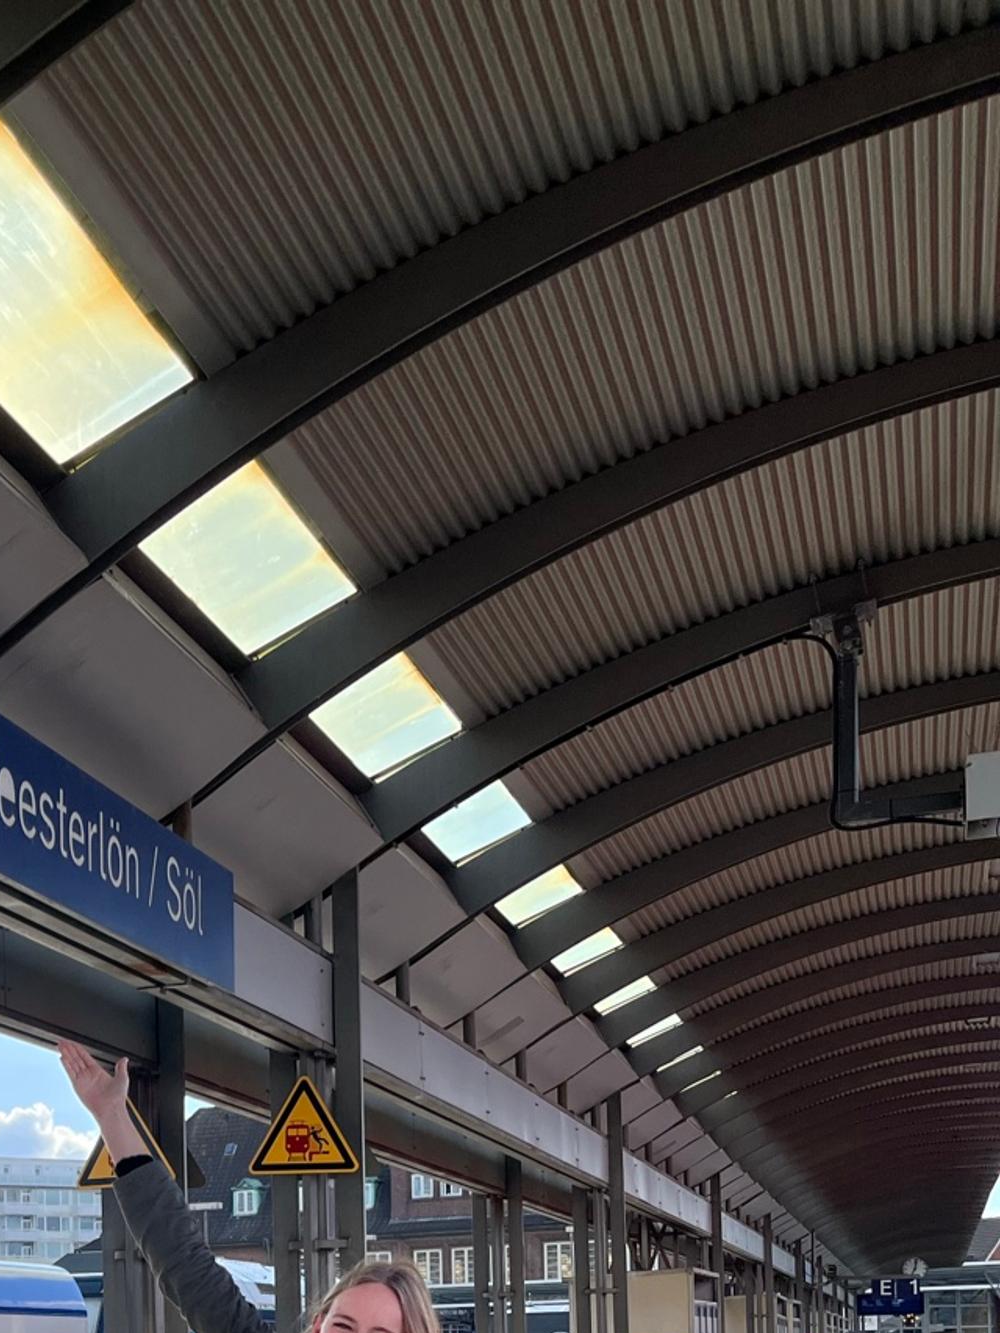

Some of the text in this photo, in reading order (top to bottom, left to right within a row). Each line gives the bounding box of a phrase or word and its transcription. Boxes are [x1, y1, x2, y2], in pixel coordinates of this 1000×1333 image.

[149, 846, 158, 908] /
[167, 855, 203, 936] Söl
[880, 1279, 918, 1295] E 1
